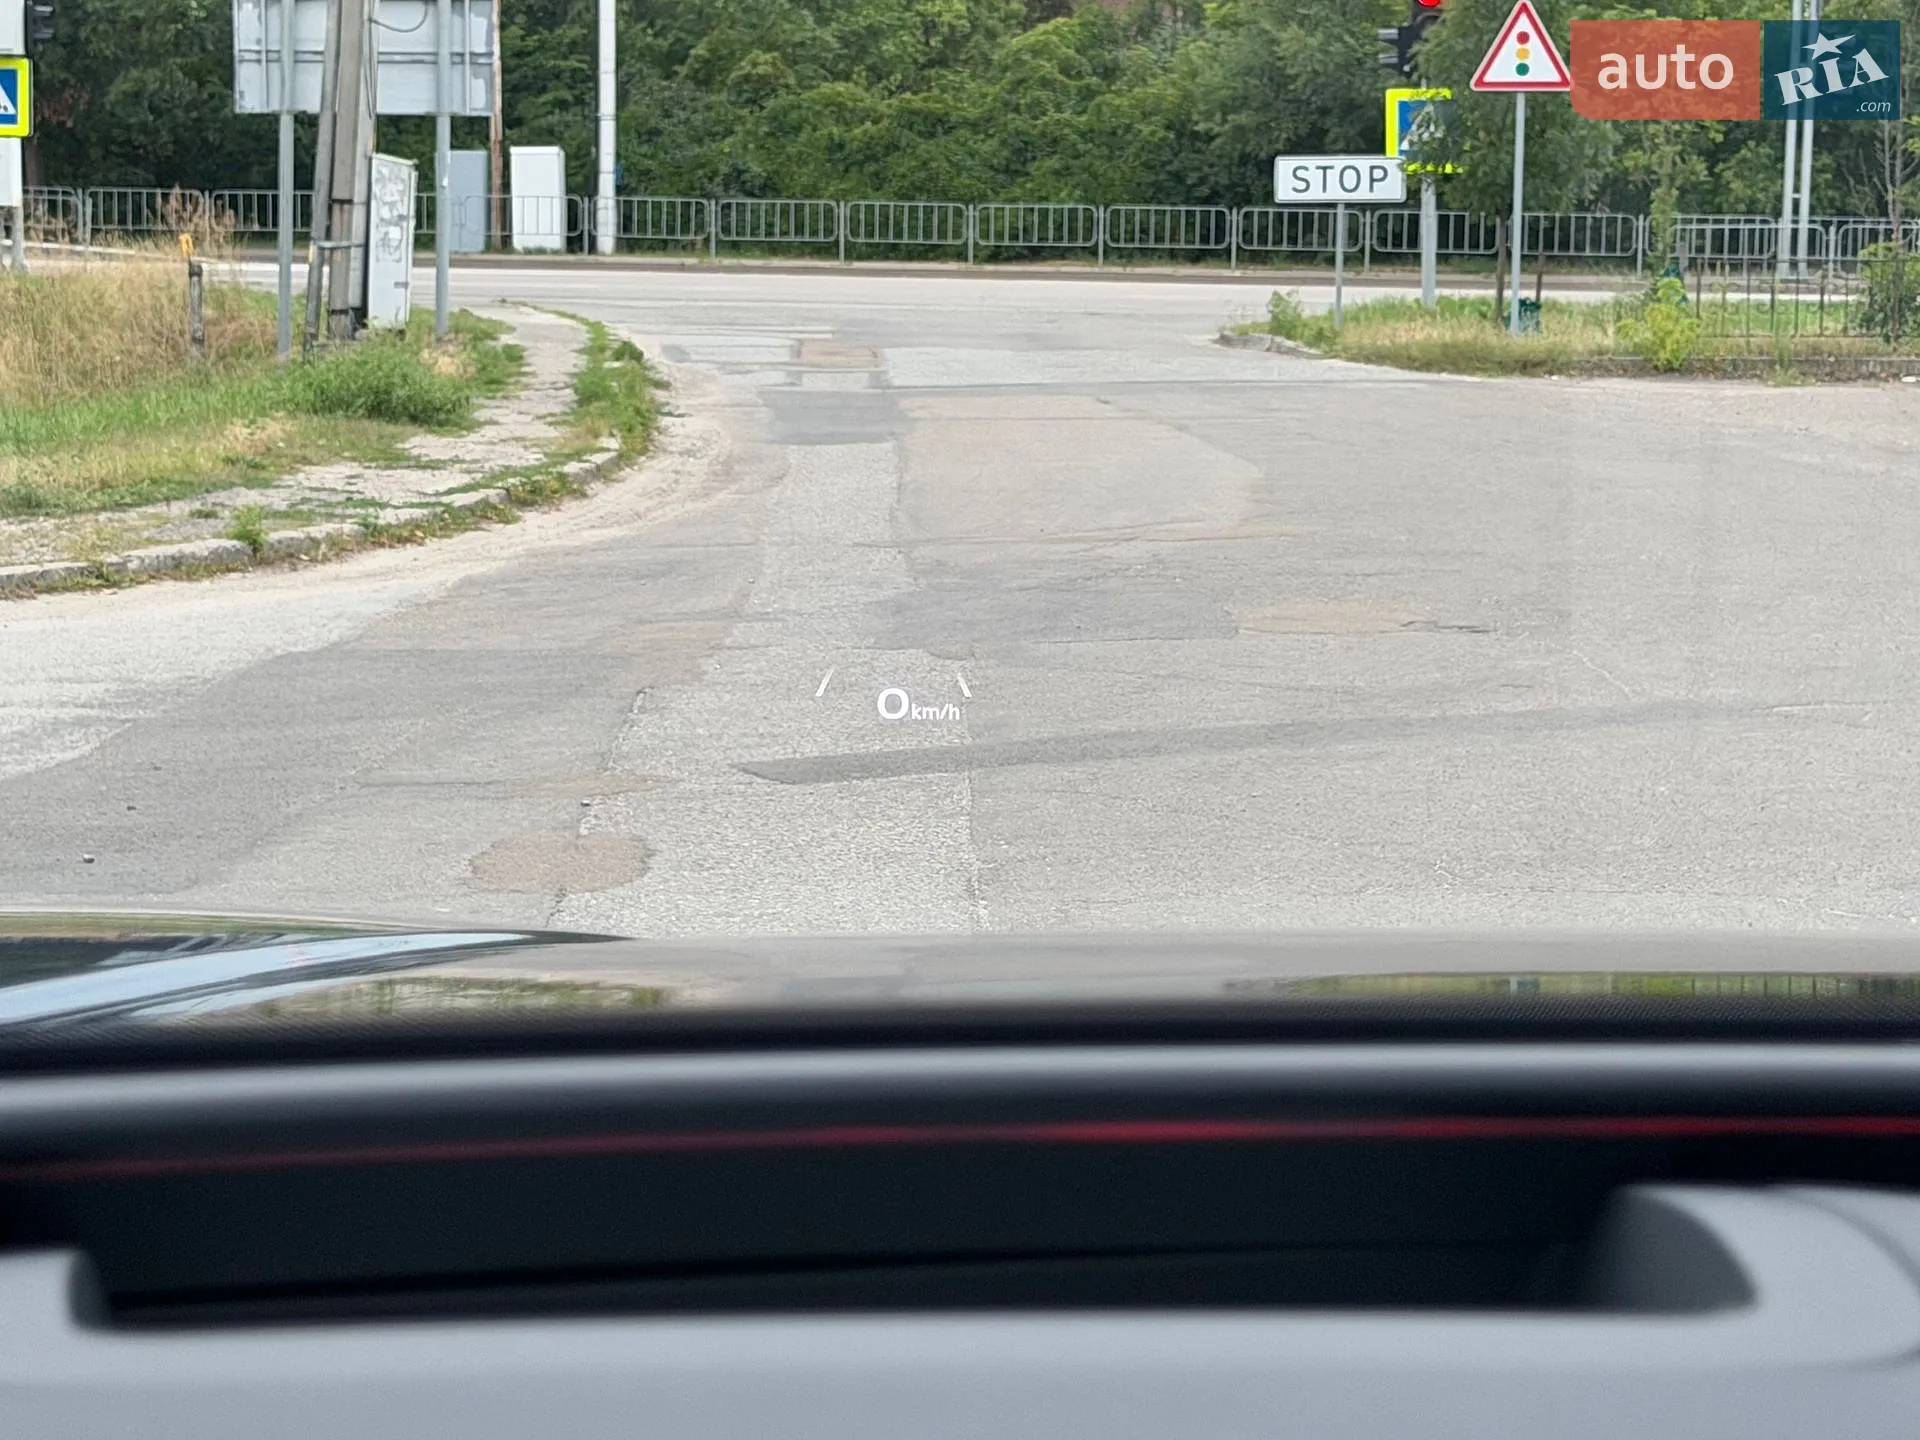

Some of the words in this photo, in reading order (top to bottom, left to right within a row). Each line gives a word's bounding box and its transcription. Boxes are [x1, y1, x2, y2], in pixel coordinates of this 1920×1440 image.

[1291, 165, 1388, 193] STOP
[877, 687, 910, 720] 0
[911, 703, 960, 720] km/h
